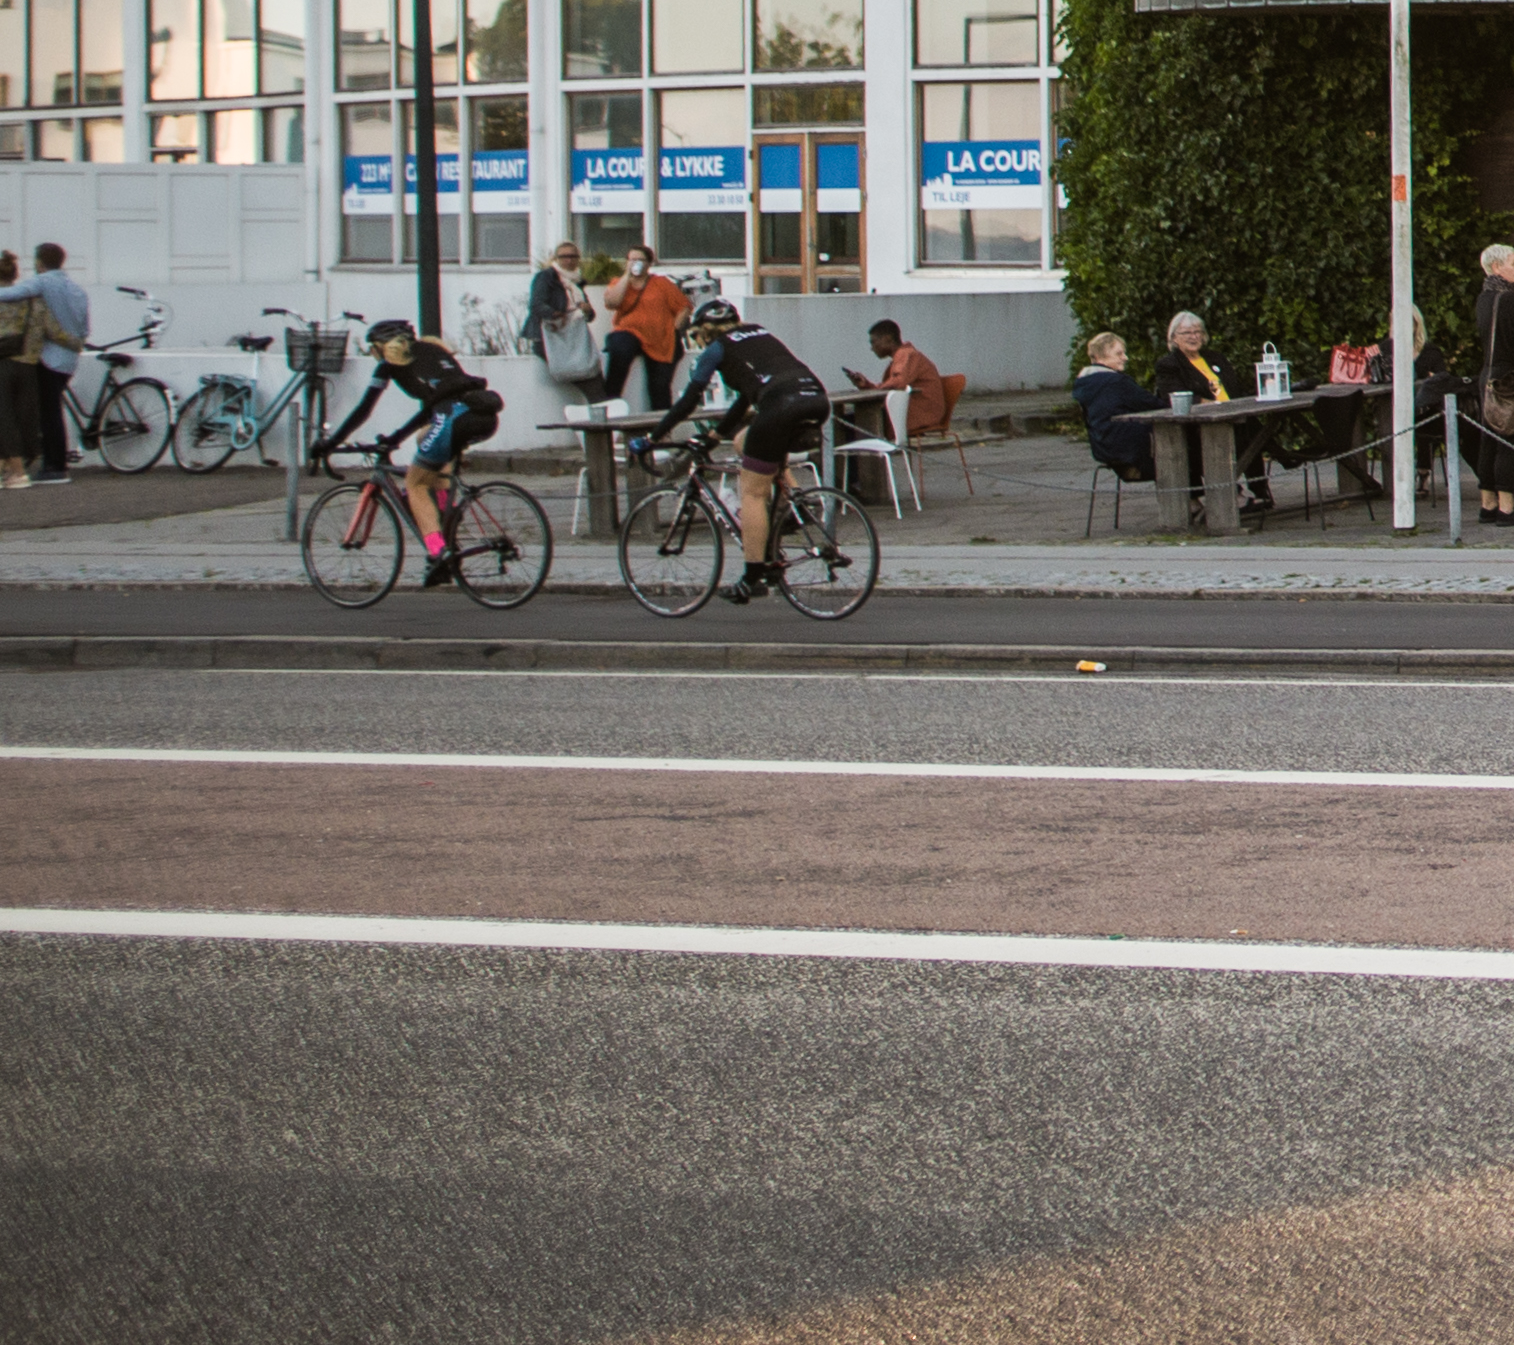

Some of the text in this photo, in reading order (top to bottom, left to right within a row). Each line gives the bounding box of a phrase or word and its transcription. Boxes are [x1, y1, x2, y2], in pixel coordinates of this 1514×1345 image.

[586, 157, 606, 179] LA
[661, 156, 673, 178] &
[676, 154, 725, 177] LYKKE
[946, 149, 1041, 173] LA COUR
[420, 412, 446, 452] CHARLIE
